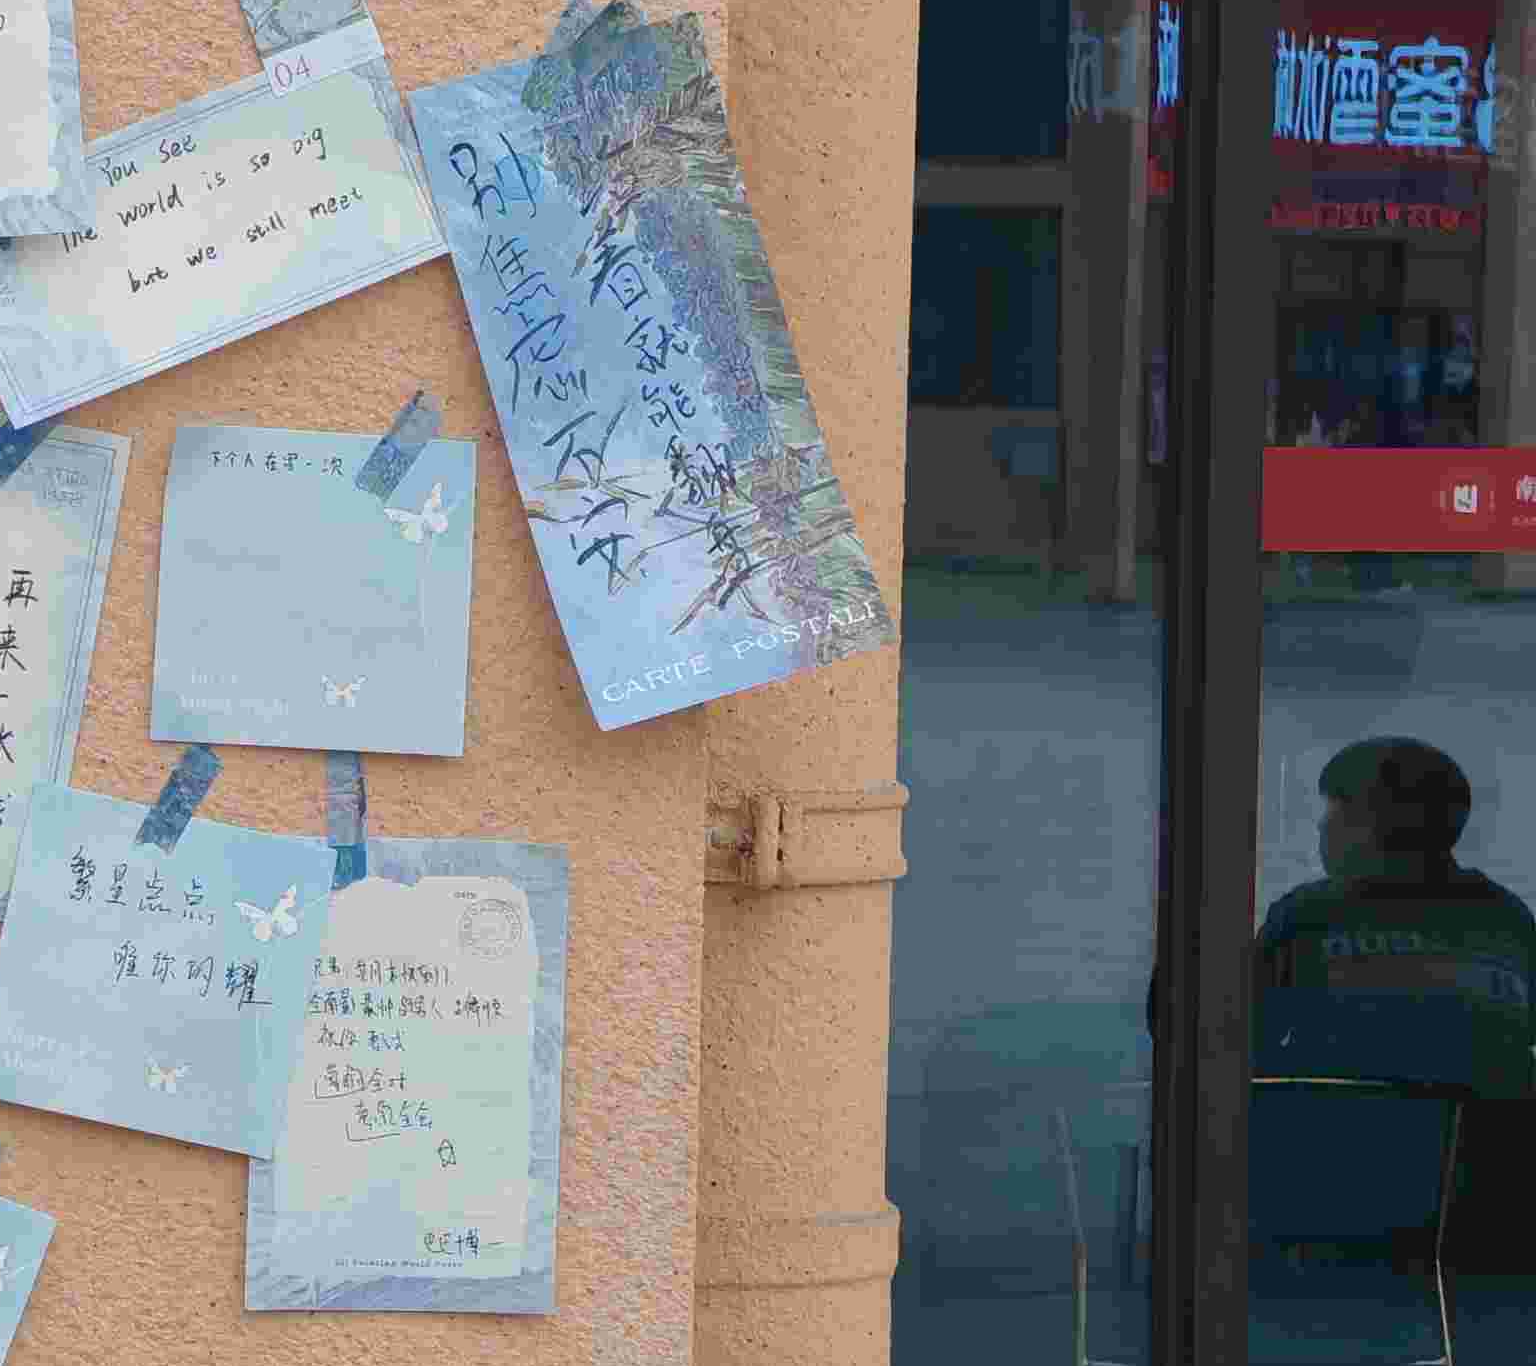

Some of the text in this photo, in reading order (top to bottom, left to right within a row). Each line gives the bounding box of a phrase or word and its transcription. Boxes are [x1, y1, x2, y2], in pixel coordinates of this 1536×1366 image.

[274, 55, 311, 90] 04
[99, 134, 198, 189] You see
[118, 184, 185, 228] world
[204, 171, 227, 192] is
[248, 151, 271, 173] so
[128, 188, 363, 294] but we still meet
[600, 649, 712, 704] CARTE
